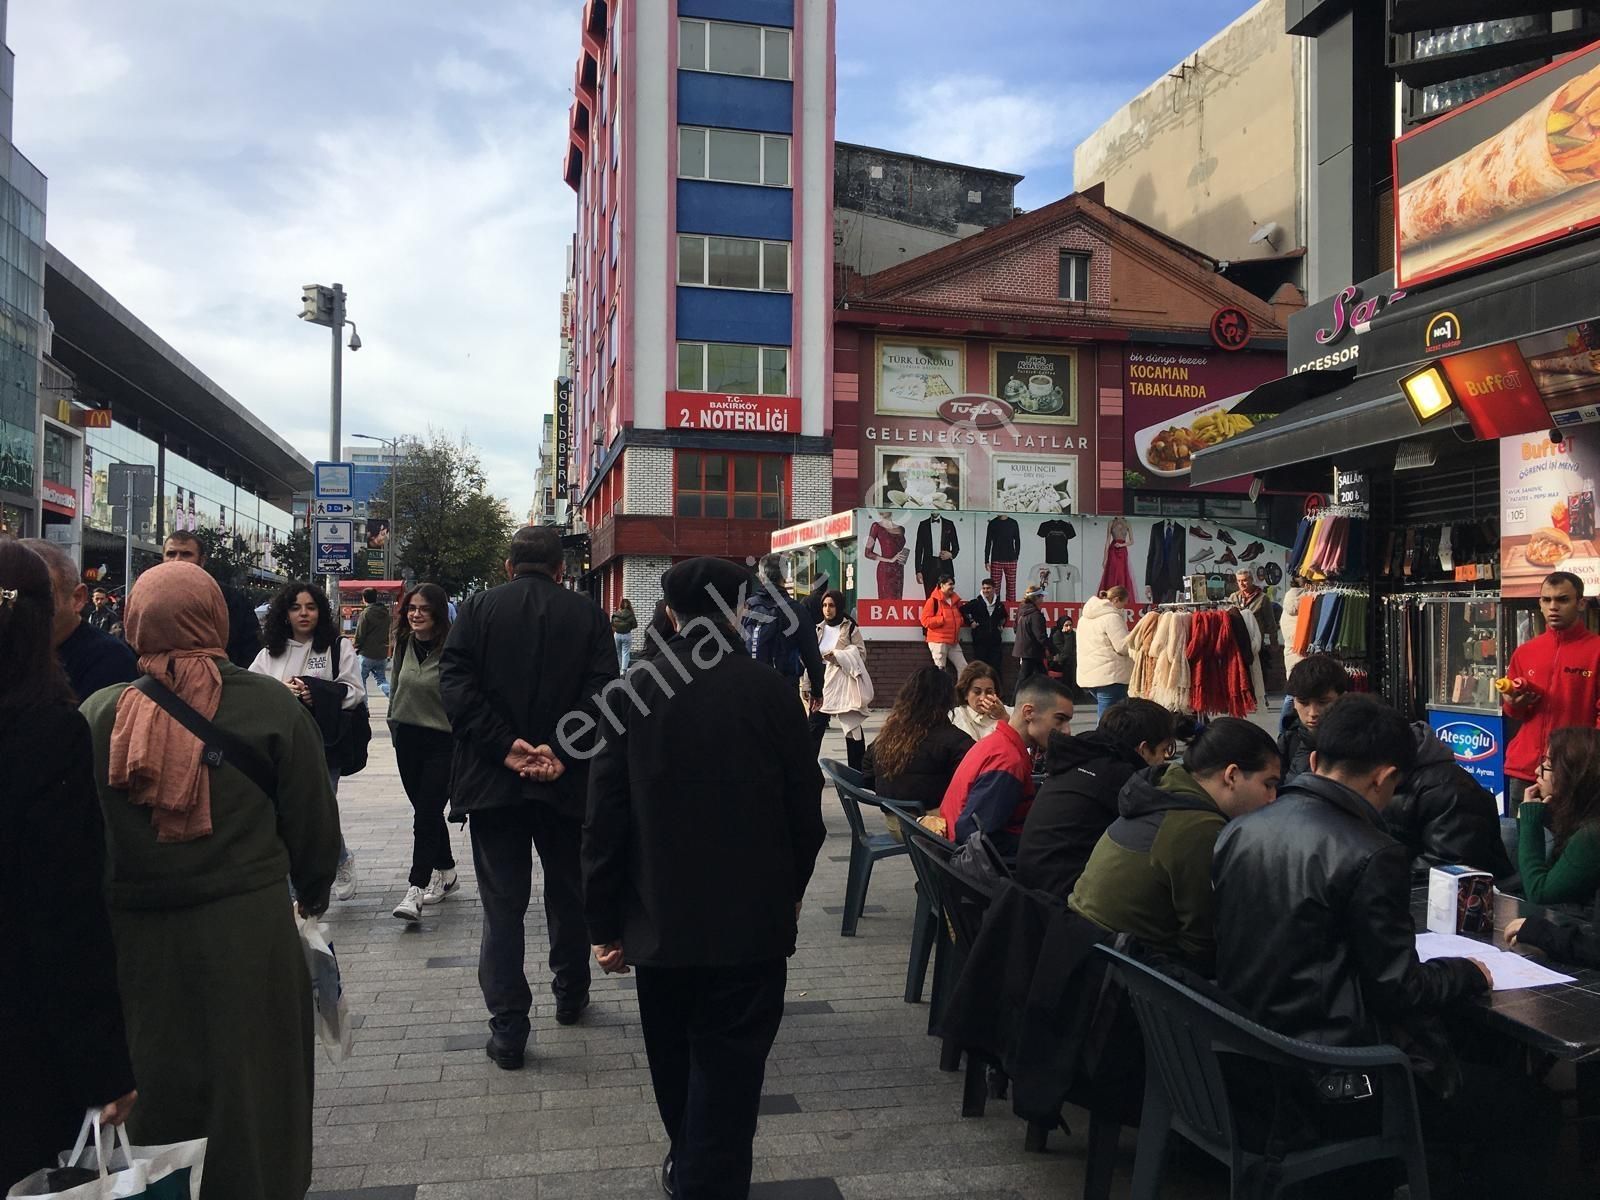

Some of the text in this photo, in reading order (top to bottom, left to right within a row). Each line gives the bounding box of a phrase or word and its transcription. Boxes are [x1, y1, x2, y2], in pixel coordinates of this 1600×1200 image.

[887, 355, 954, 367] TÜRK LOKUMU
[1292, 345, 1360, 375] ACCESSOR
[1130, 364, 1188, 380] KOCAMAN
[1130, 382, 1207, 398] TABAKLARDA
[709, 401, 758, 410] BAKIRKÖY
[680, 408, 788, 432] 2. NOTERLİĞİ
[558, 390, 568, 493] GOLDBERK
[865, 427, 1089, 449] GELENEKSEL TATLAR
[1010, 464, 1032, 472] KURU
[1341, 491, 1354, 502] 200
